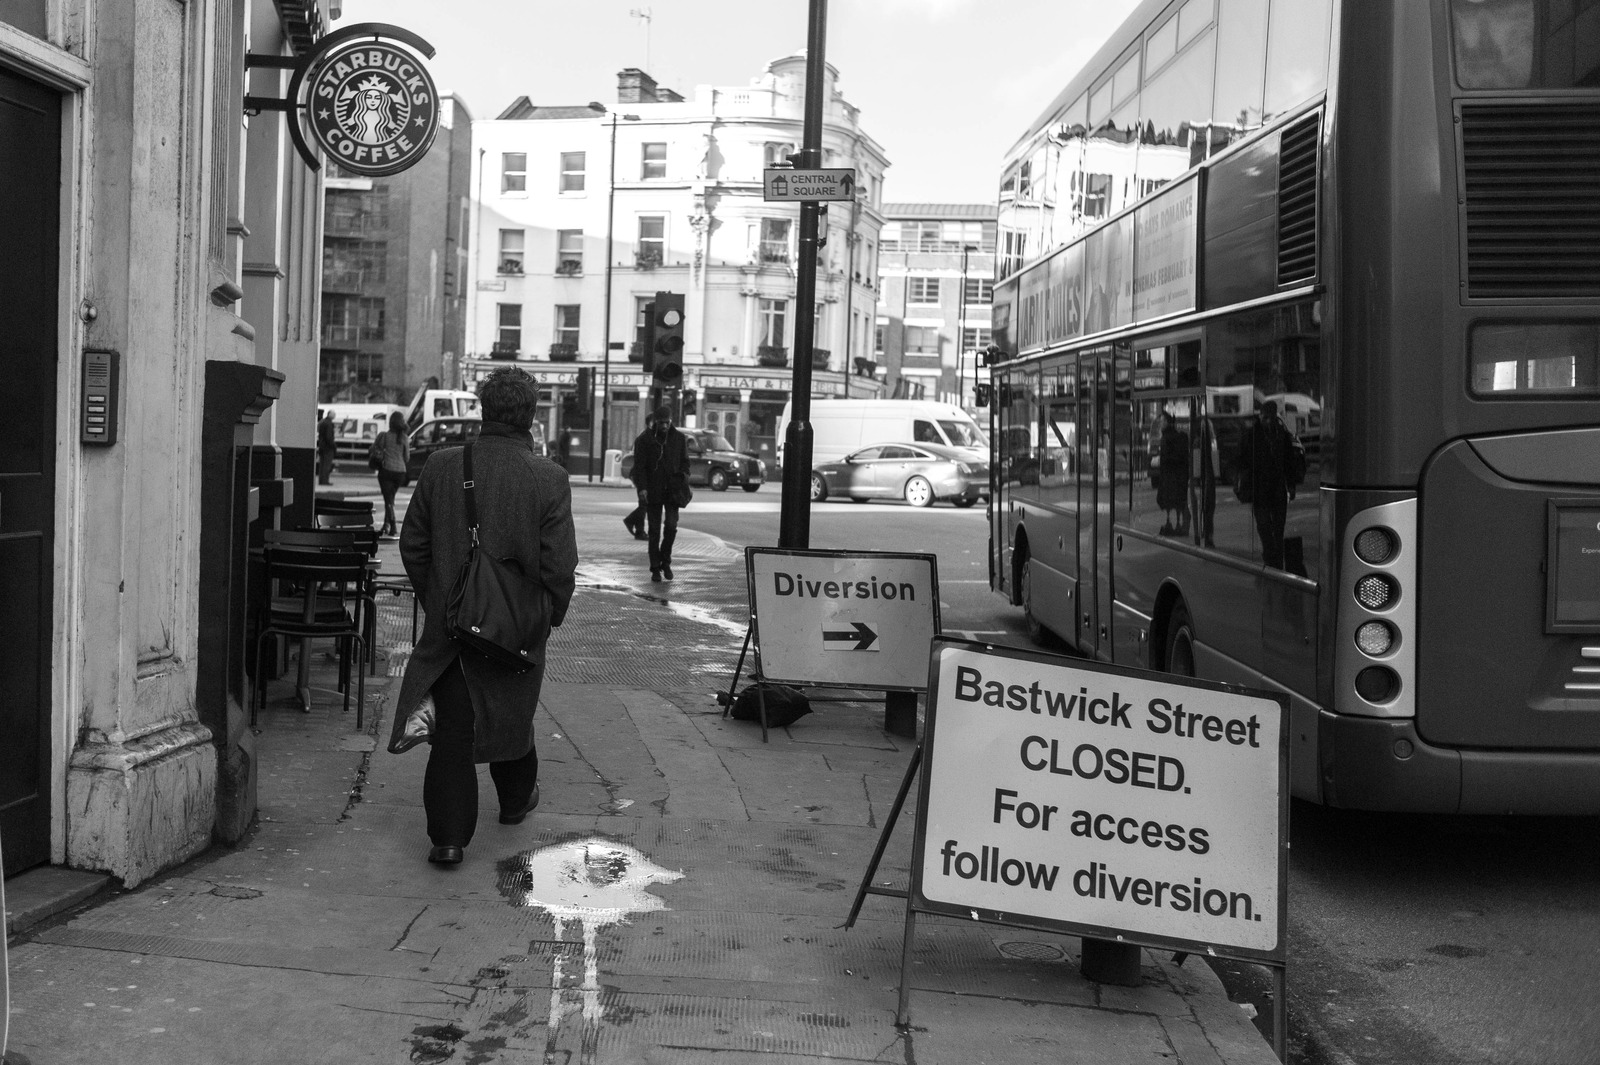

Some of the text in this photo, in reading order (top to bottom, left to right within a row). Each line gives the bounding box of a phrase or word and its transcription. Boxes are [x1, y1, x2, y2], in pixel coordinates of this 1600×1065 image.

[318, 51, 429, 106] STARBUCKS
[326, 128, 414, 163] COFFEE
[790, 175, 839, 184] CENTRAL
[793, 187, 836, 196] SQUARE
[728, 377, 758, 389] HAT
[764, 379, 774, 389] &
[773, 571, 915, 601] Diversion
[954, 665, 1261, 748] Bastwick Street
[1020, 735, 1192, 795] CLOSED.
[993, 787, 1211, 855] For access
[940, 839, 1262, 922] follow diversion.
